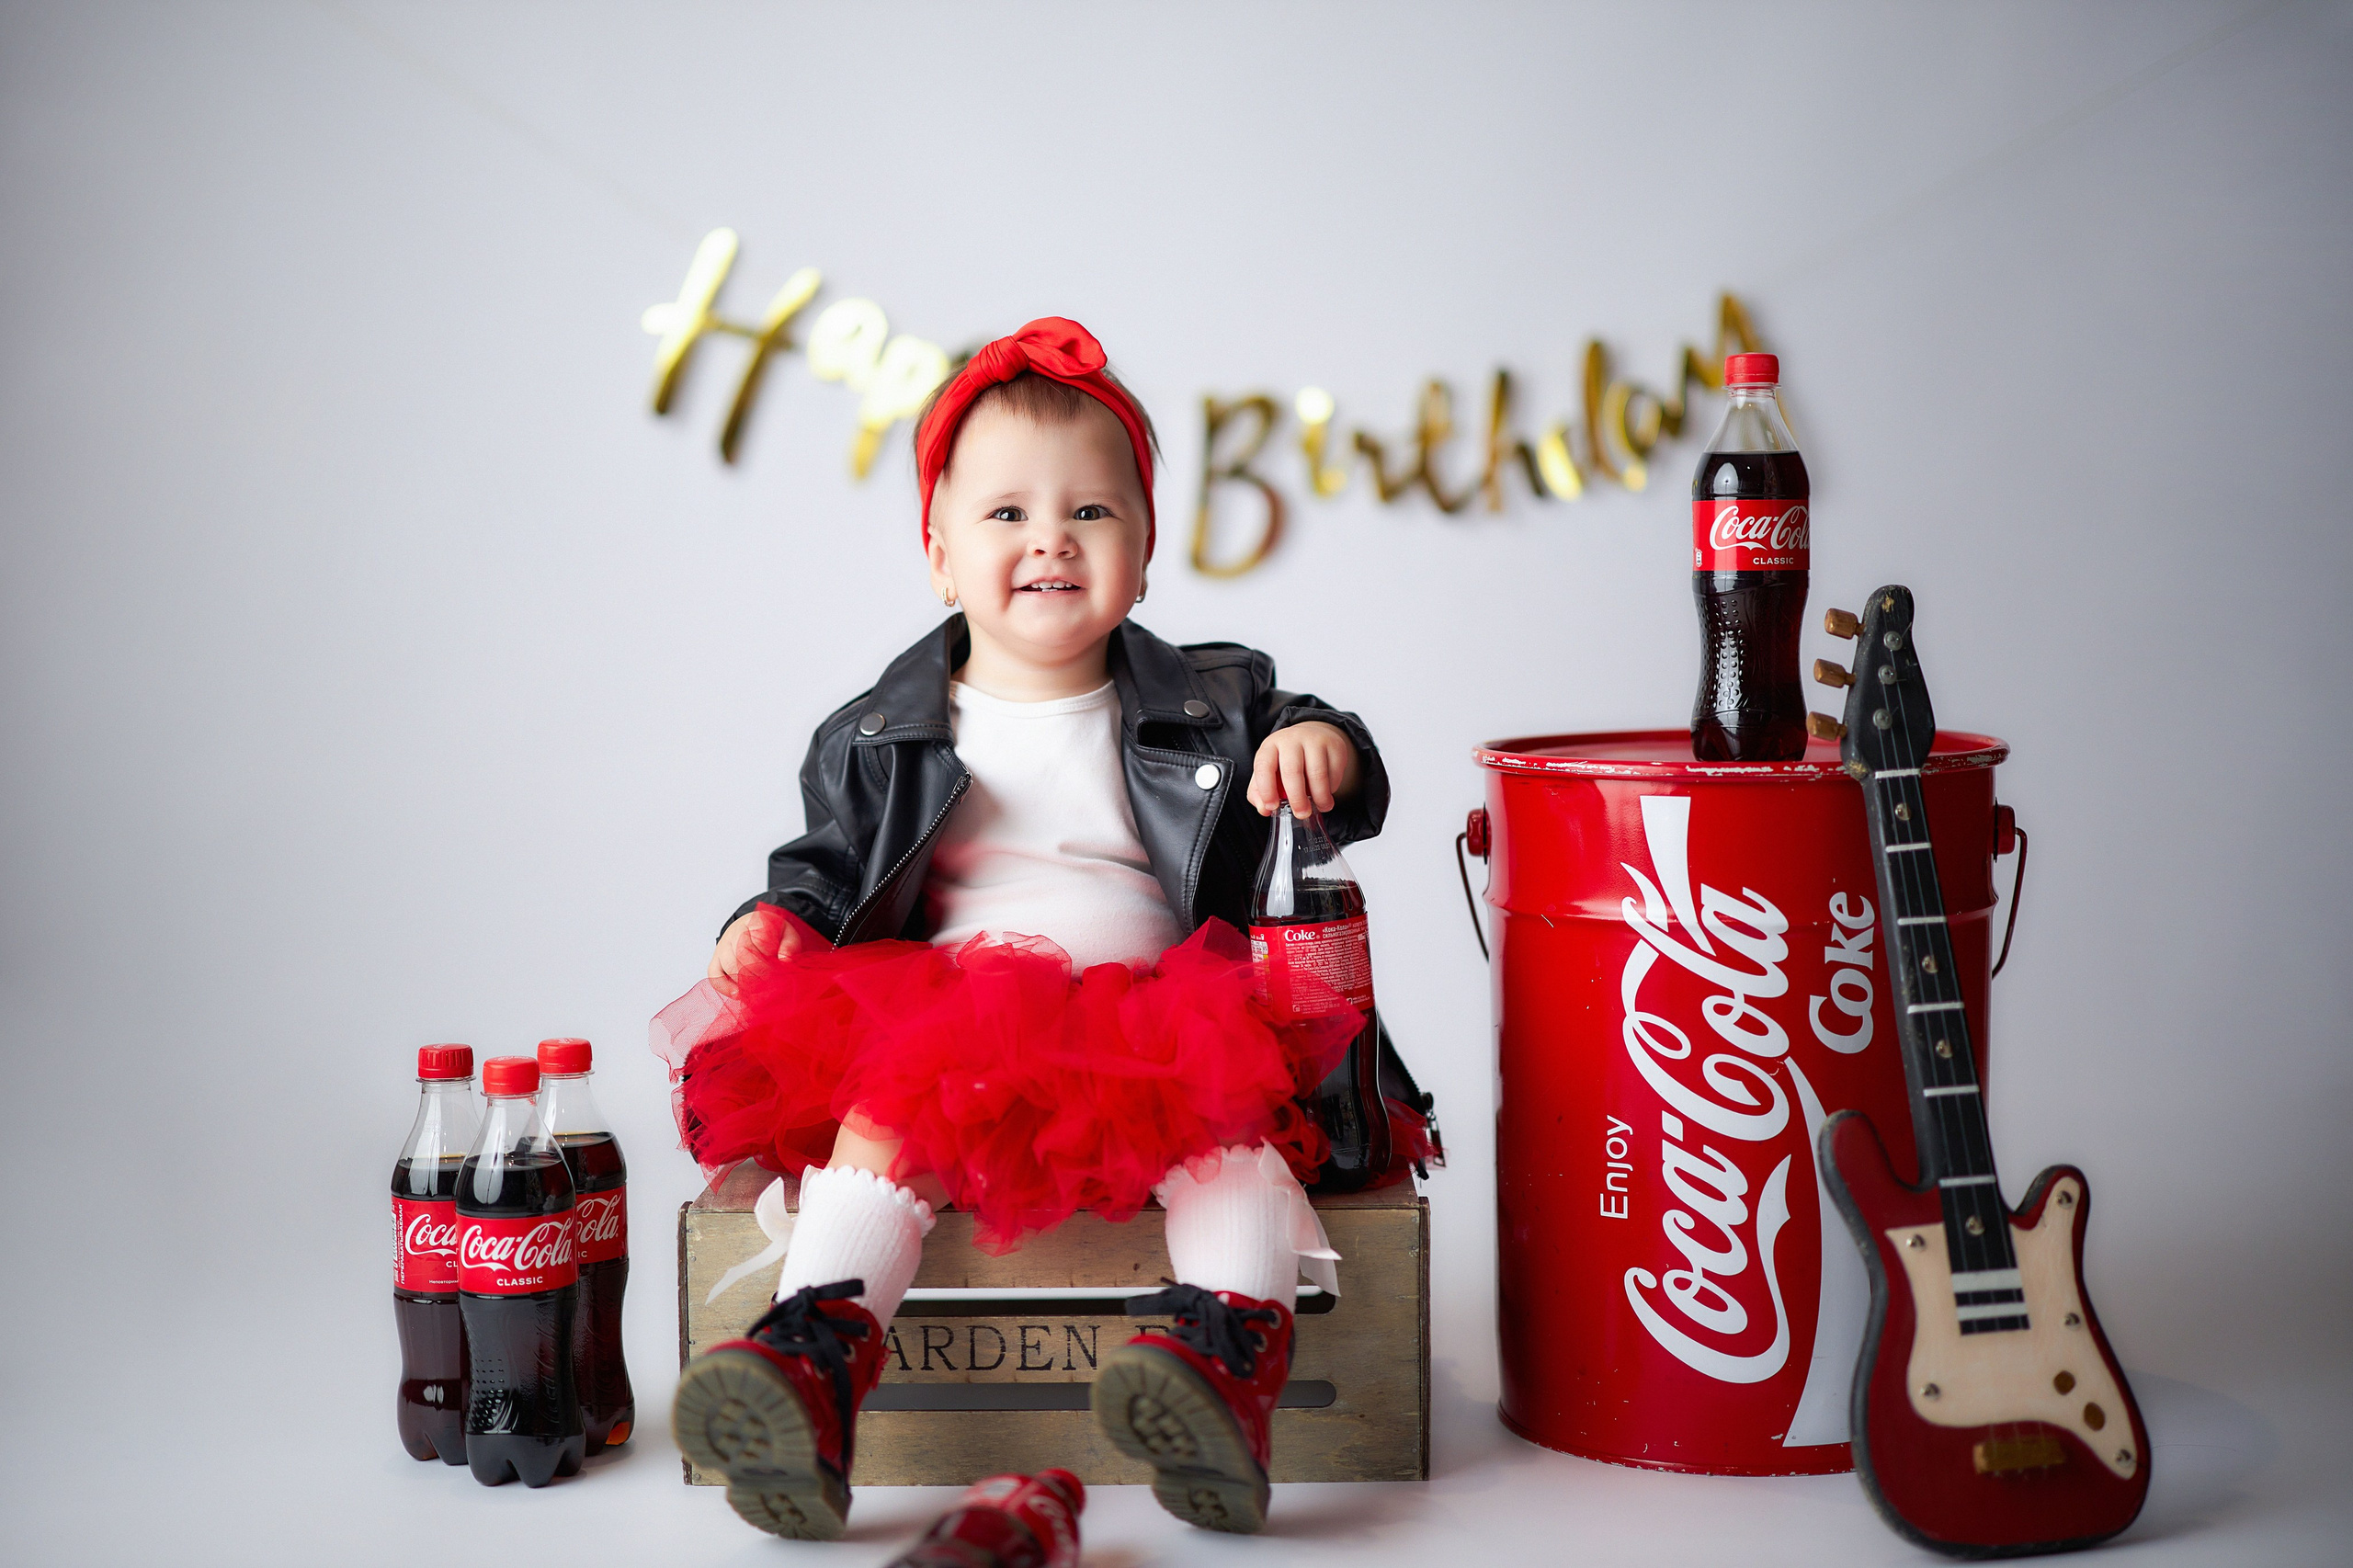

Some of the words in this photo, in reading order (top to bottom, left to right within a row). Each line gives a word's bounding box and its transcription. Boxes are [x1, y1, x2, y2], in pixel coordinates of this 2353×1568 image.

[641, 226, 965, 481] Hap
[1753, 557, 1793, 565] CLASSIC
[1284, 929, 1315, 942] Coke
[1809, 891, 1876, 1055] Coke
[1620, 861, 1792, 1384] Coca-Cola
[1599, 1114, 1633, 1221] Enjoy
[460, 1216, 574, 1272] Coca-Cola
[496, 1276, 543, 1287] CLASSIC
[881, 1324, 1100, 1371] ARDEN
